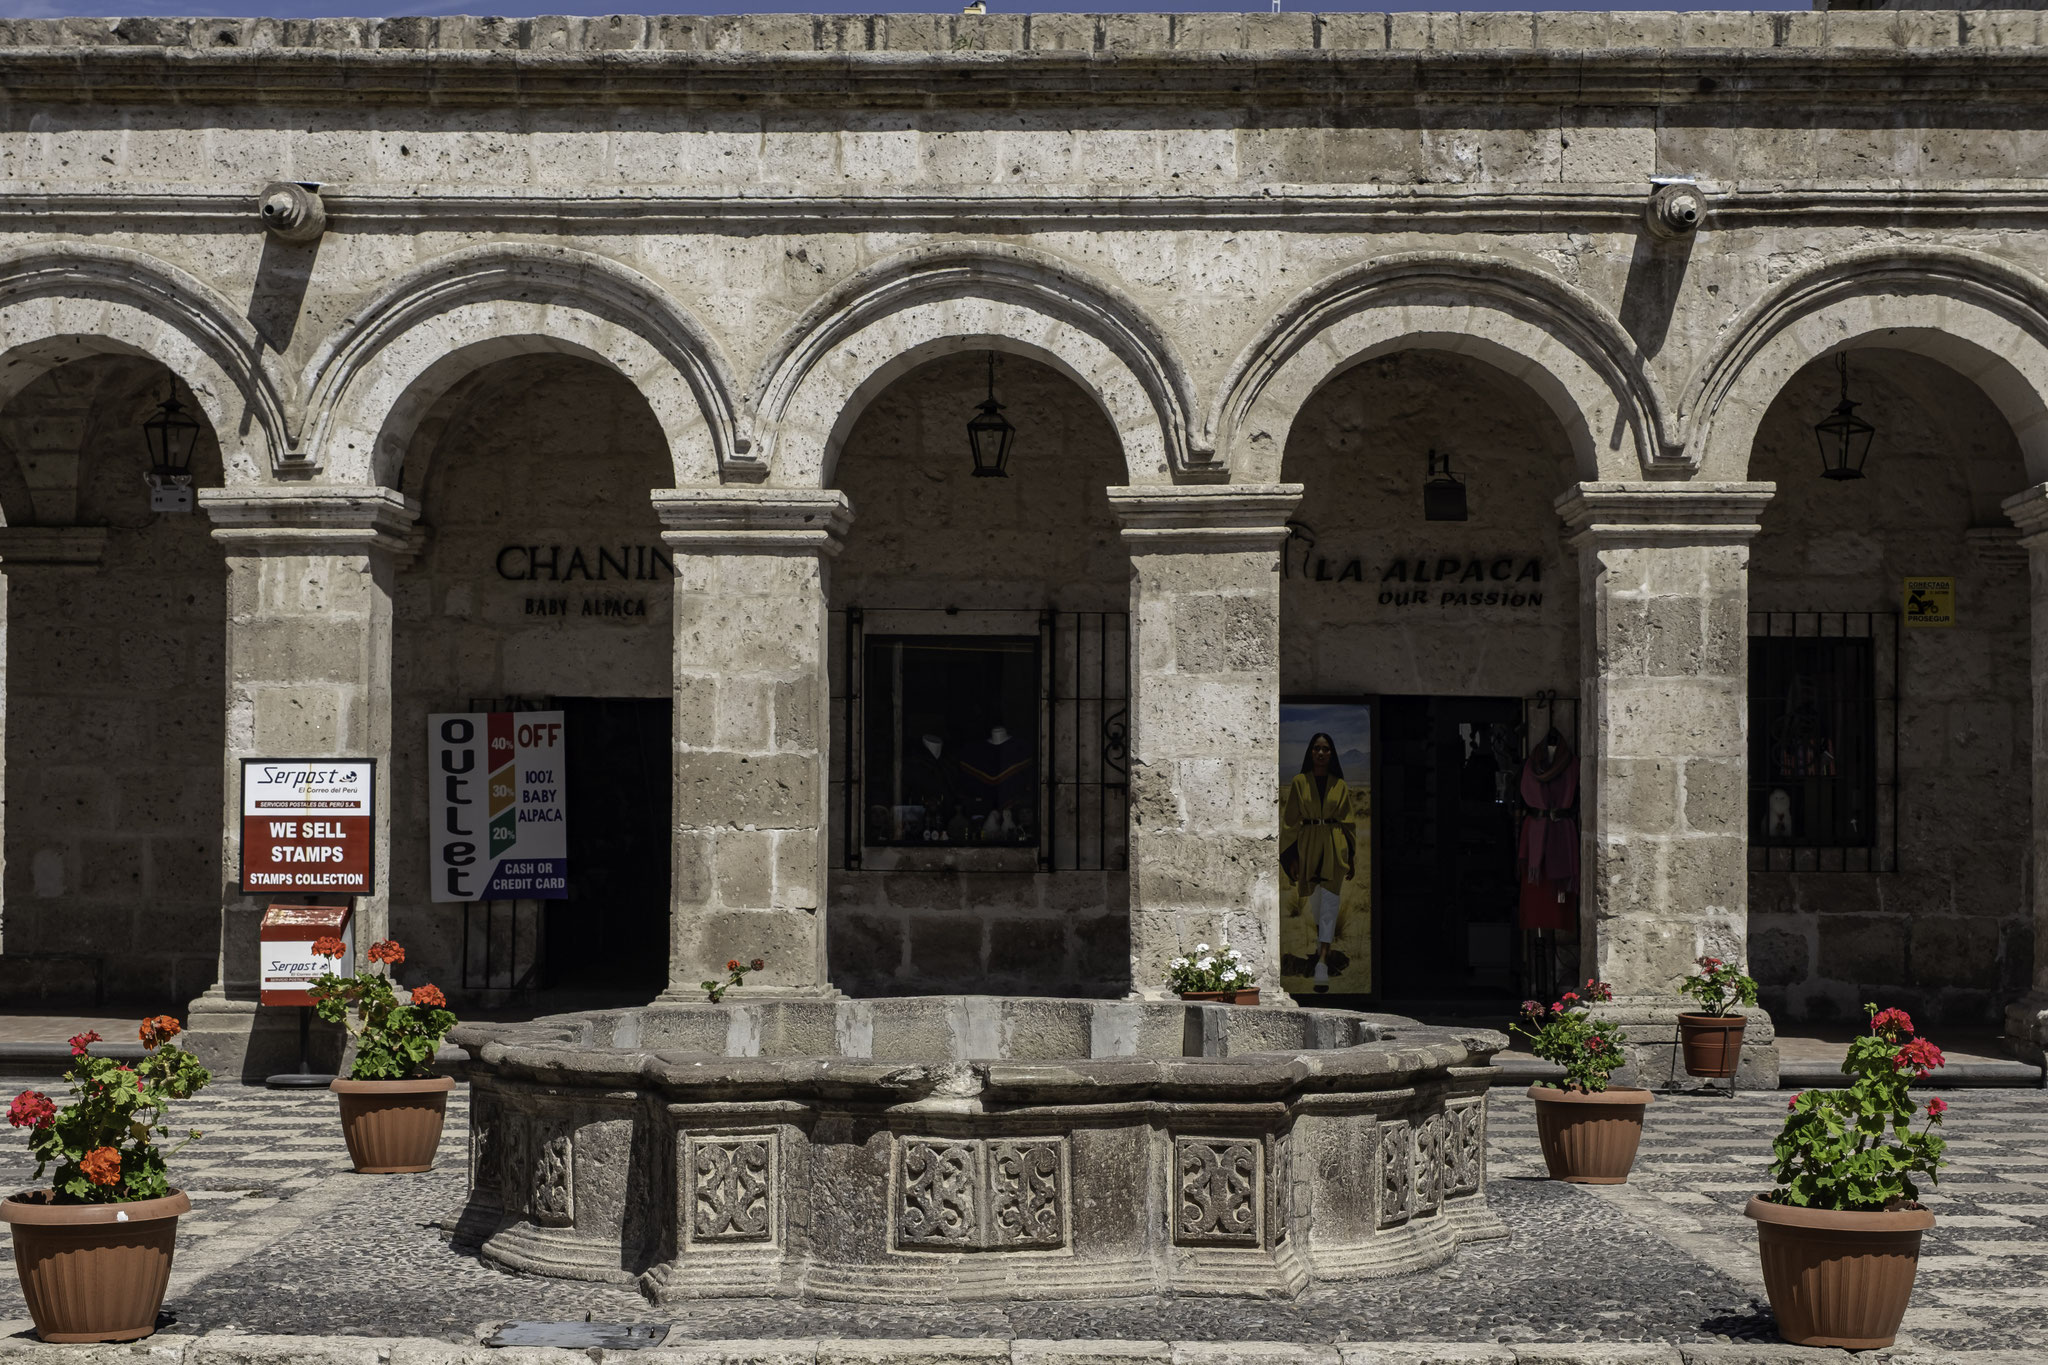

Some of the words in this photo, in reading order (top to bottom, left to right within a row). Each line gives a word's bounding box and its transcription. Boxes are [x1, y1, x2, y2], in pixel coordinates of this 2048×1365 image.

[496, 545, 674, 582] CHANIN
[1315, 558, 1362, 583] LA
[1382, 558, 1542, 584] ALPACA
[525, 598, 567, 616] BABY
[581, 598, 646, 616] ALPACA
[1378, 591, 1429, 606] OUR
[1440, 592, 1543, 608] PASSION
[517, 723, 562, 748] OFF
[491, 737, 514, 750] 40%
[257, 766, 339, 789] Serpost
[525, 769, 554, 784] 100%
[342, 786, 358, 794] Perú
[492, 784, 515, 798] 30%
[522, 789, 557, 804] BABY
[518, 808, 563, 823] ALPACA
[269, 822, 297, 839] WE
[302, 822, 347, 839] SELL
[493, 827, 515, 840] 20%
[271, 846, 344, 863] STAMPS
[505, 863, 534, 875] CASH
[537, 863, 553, 874] OR
[250, 873, 293, 885] STAMPS
[295, 873, 364, 885] COLLECTION
[493, 878, 532, 890] CREDIT
[535, 878, 565, 889] CARD
[268, 961, 317, 973] Serpost
